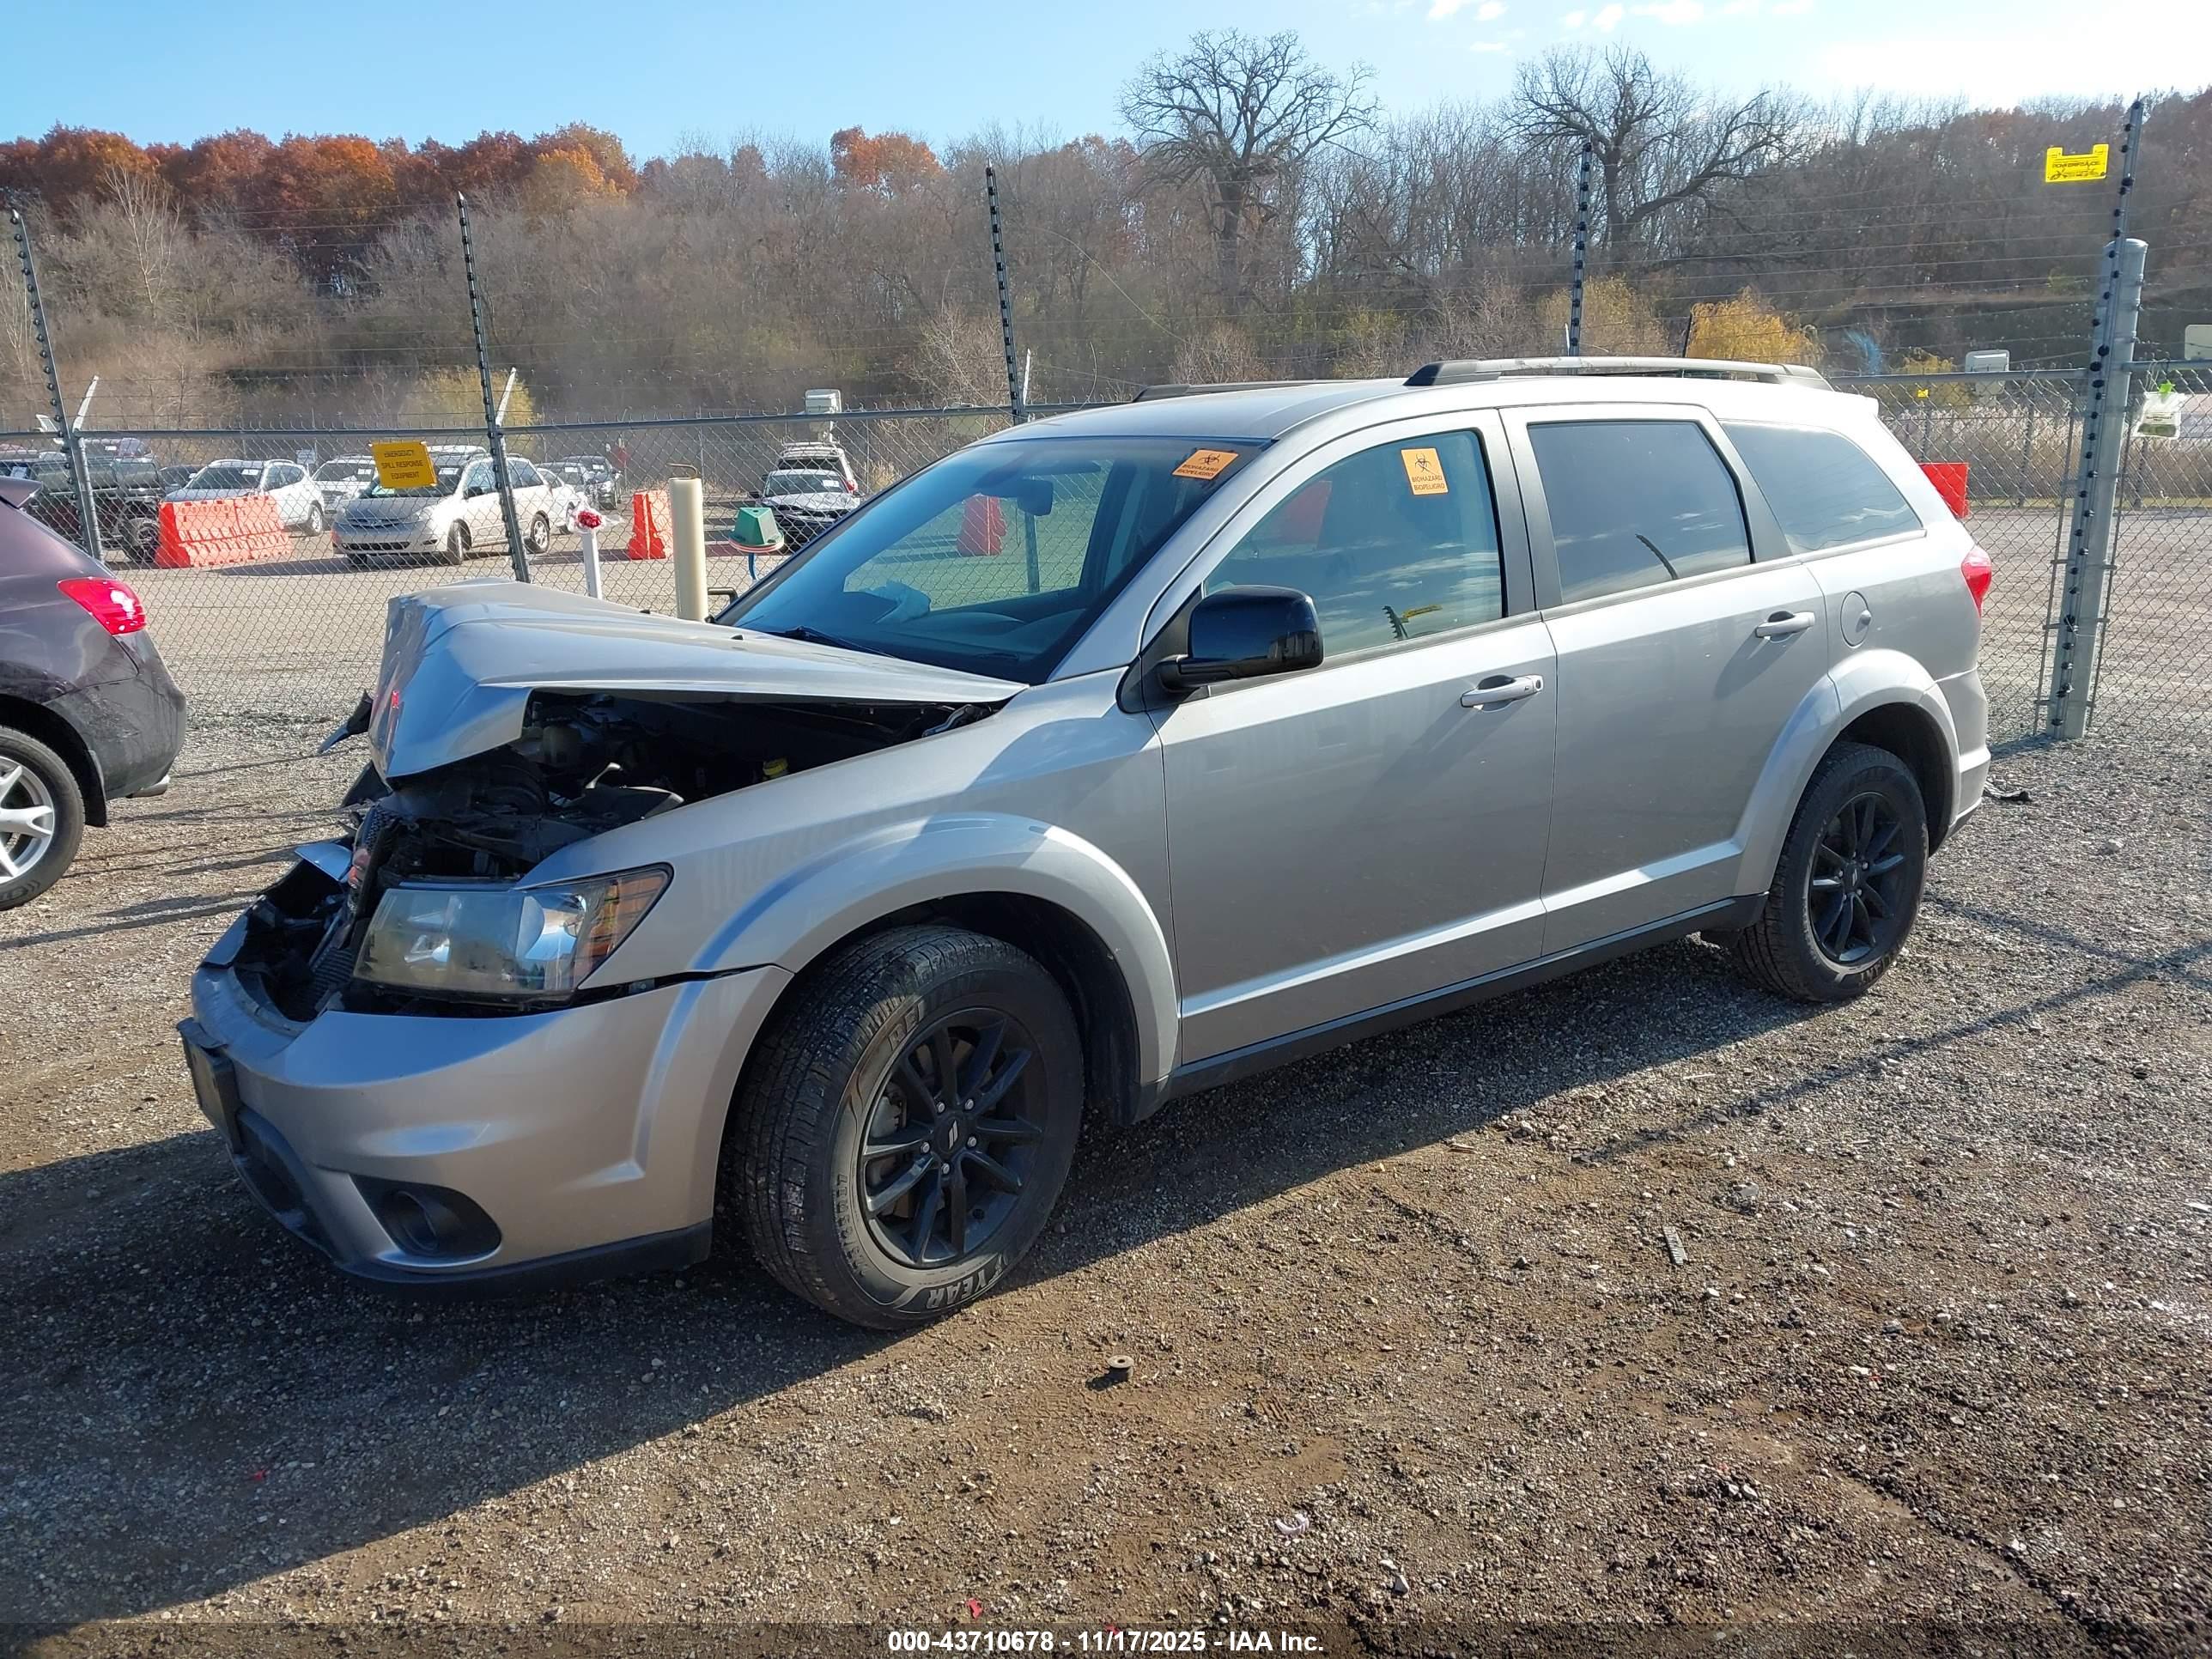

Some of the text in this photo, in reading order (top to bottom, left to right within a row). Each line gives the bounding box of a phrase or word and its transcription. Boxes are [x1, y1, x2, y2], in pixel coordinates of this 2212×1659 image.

[381, 459, 423, 469] SPILL RESPONSE
[1414, 483, 1445, 491] BIOPELIGRO
